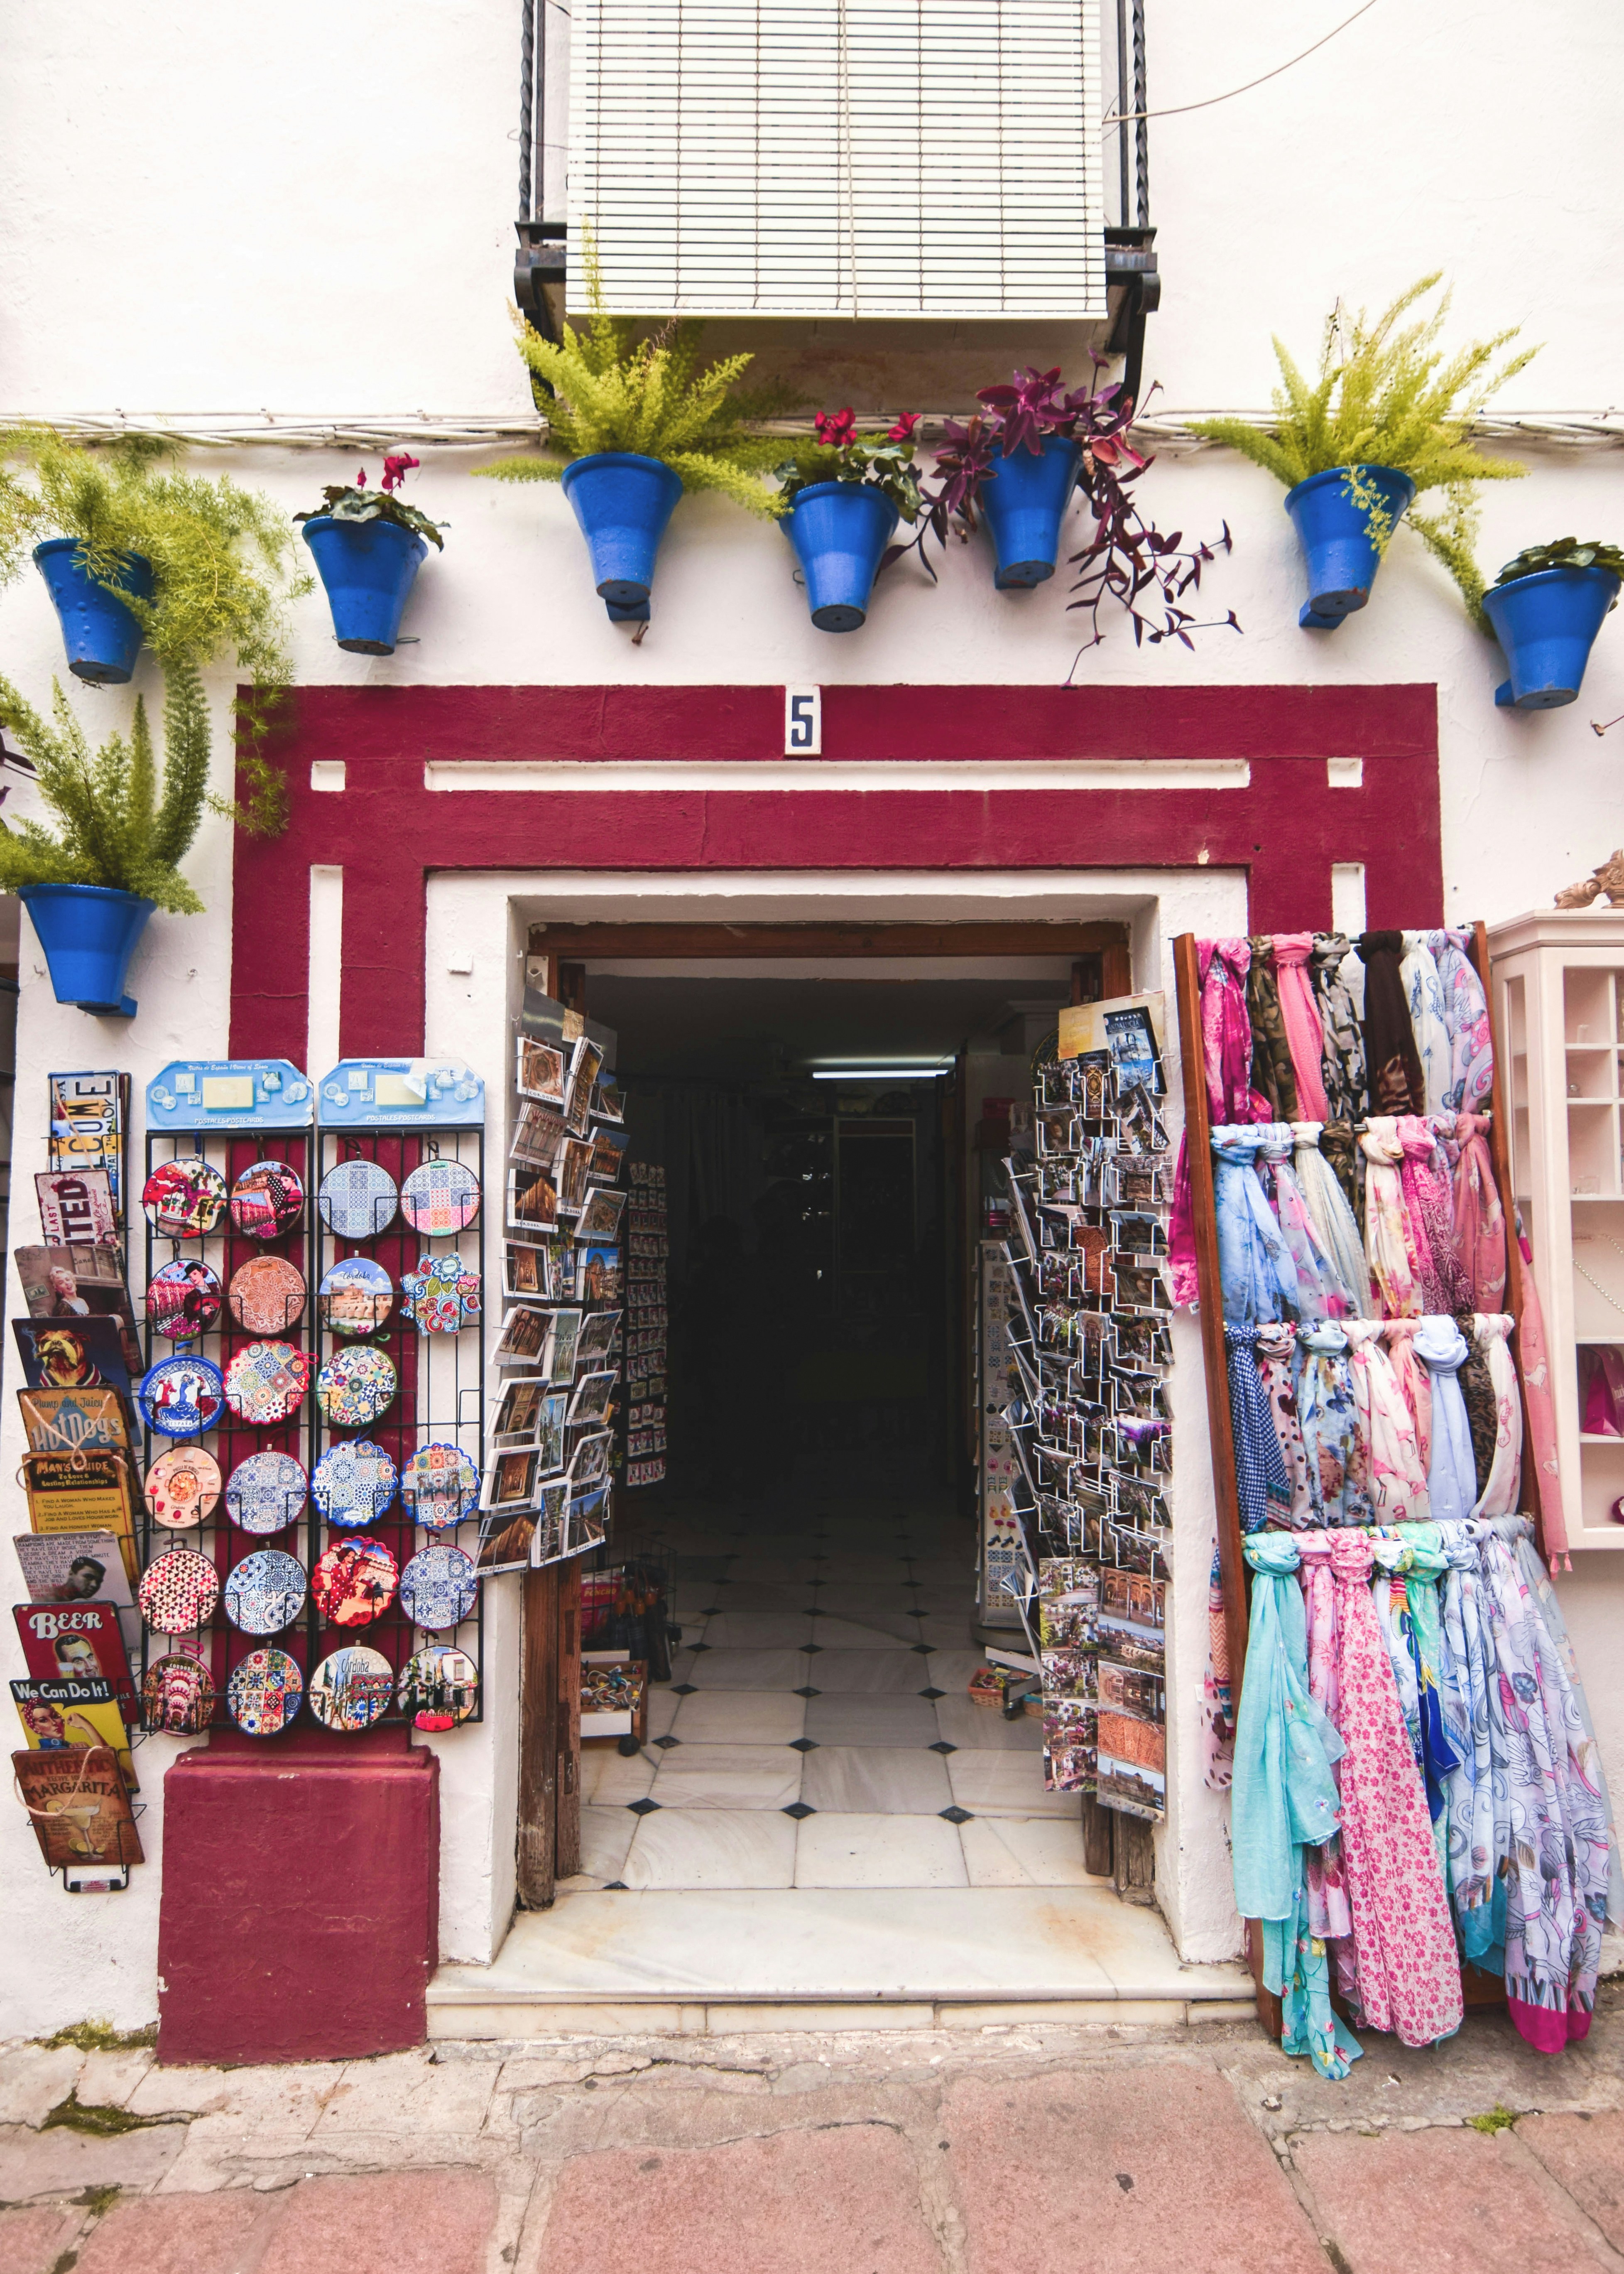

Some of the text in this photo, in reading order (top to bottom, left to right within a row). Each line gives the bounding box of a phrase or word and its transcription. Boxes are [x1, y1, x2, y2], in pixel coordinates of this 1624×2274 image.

[791, 695, 813, 747] 5
[47, 1205, 59, 1232] LAST
[62, 1398, 76, 1408] and
[80, 1398, 103, 1408] Juicy
[29, 1612, 103, 1639] BEER
[16, 1683, 39, 1699] We
[40, 1683, 69, 1698] Can
[70, 1682, 91, 1697] Do
[91, 1681, 110, 1697] It!
